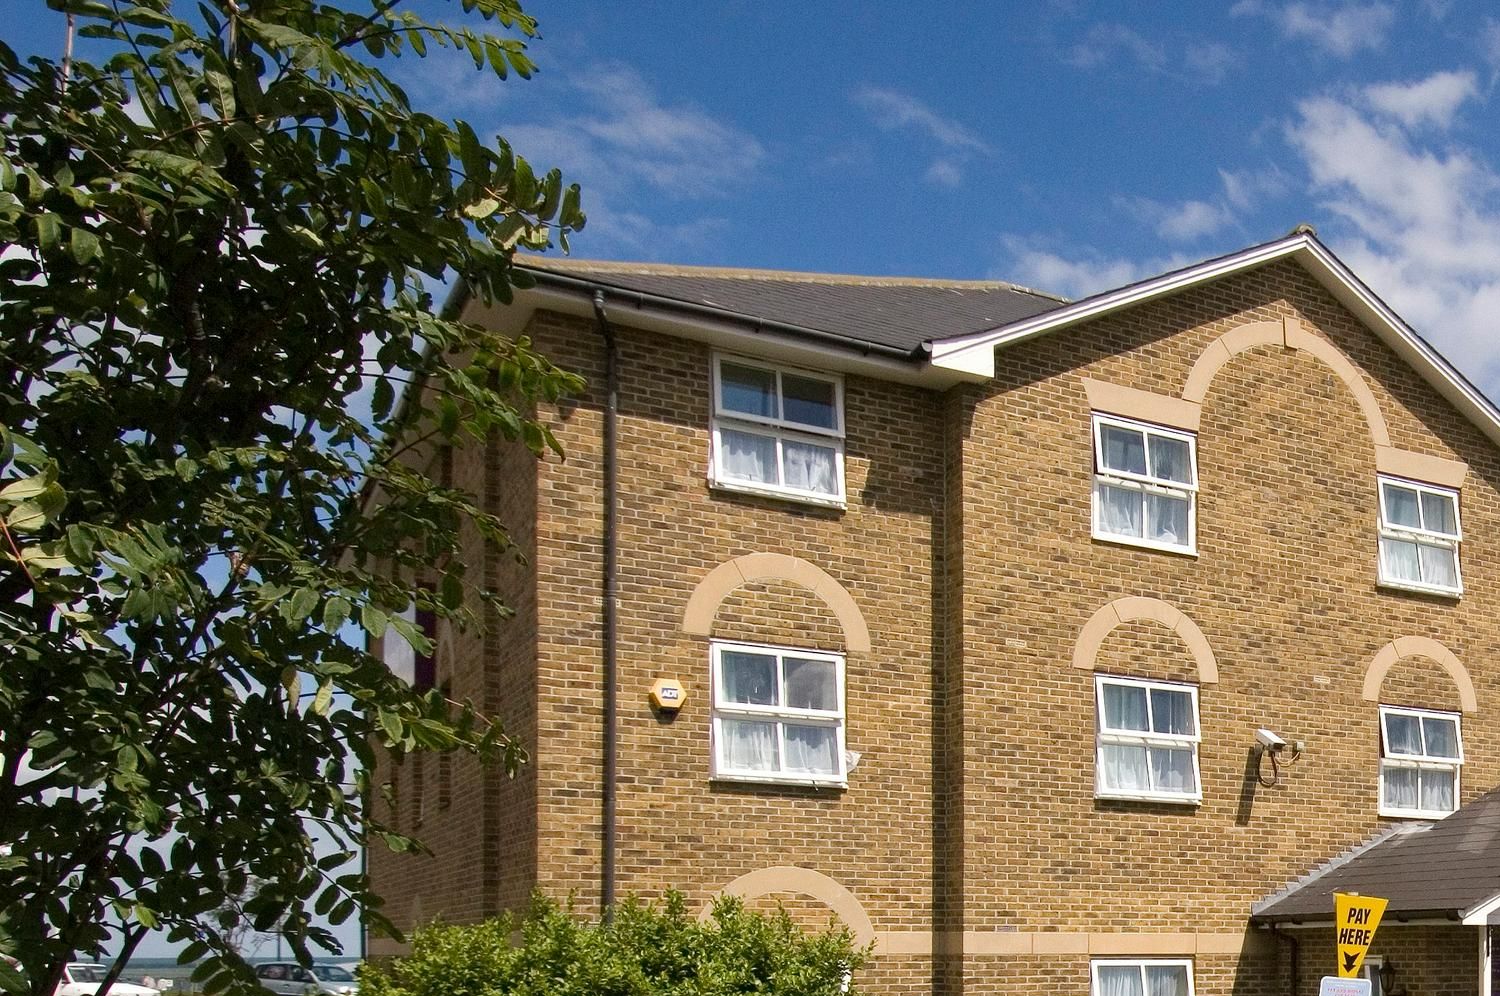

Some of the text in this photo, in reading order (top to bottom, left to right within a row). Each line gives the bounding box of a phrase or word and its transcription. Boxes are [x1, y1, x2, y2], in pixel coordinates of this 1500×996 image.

[662, 688, 678, 699] ADT
[1347, 907, 1371, 925] PAY
[1338, 928, 1371, 946] HERE
